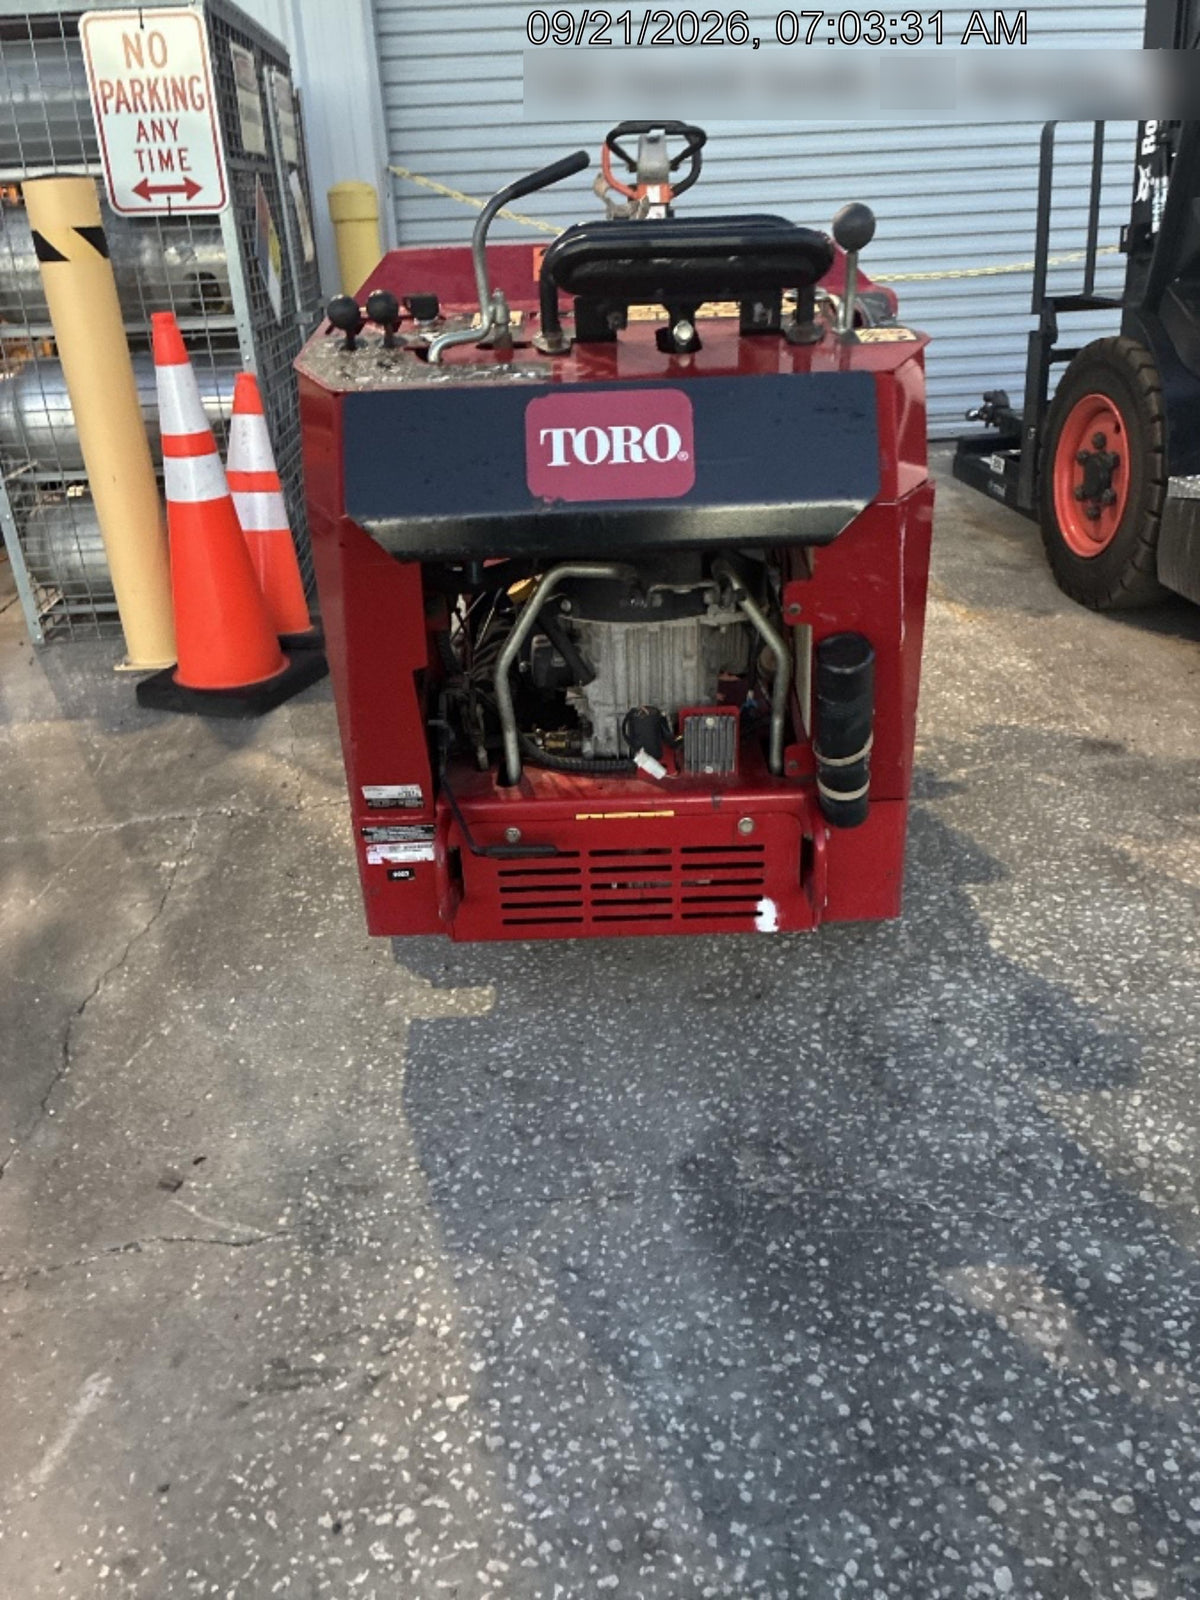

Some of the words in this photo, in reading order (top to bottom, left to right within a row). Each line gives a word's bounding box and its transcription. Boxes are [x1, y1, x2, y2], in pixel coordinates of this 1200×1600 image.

[122, 31, 168, 69] NO
[99, 75, 206, 115] PARKING
[136, 118, 180, 144] ANY
[134, 148, 192, 173] TIME
[539, 423, 682, 467] TORO
